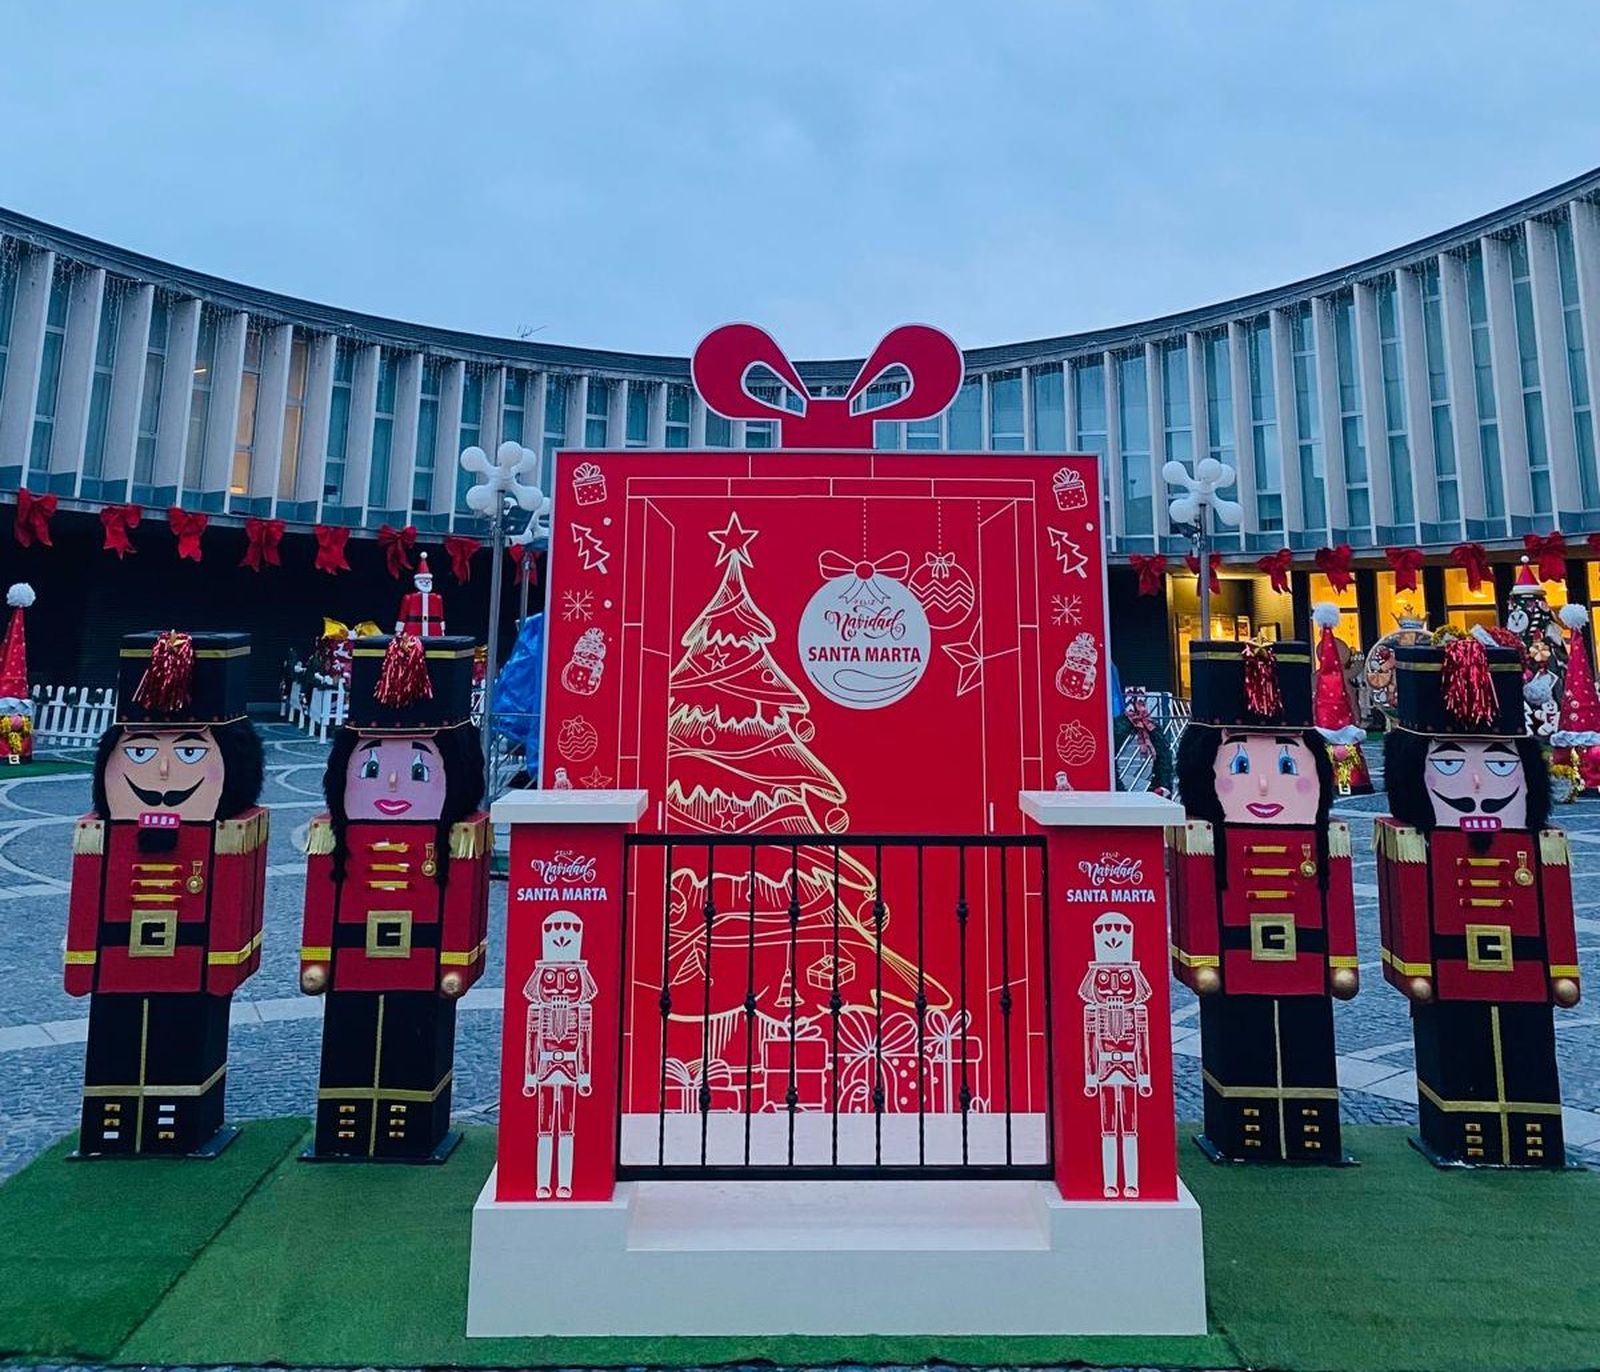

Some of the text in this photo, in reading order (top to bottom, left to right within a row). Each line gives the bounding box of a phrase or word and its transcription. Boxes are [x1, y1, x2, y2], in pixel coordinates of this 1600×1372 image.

[824, 606, 906, 642] Navidad
[808, 646, 921, 663] SANTA MARTA
[531, 855, 597, 885] Navidad
[1078, 857, 1144, 886] Navidad
[517, 888, 608, 901] SANTA MARTA
[1066, 889, 1156, 903] SANTA MARTA
